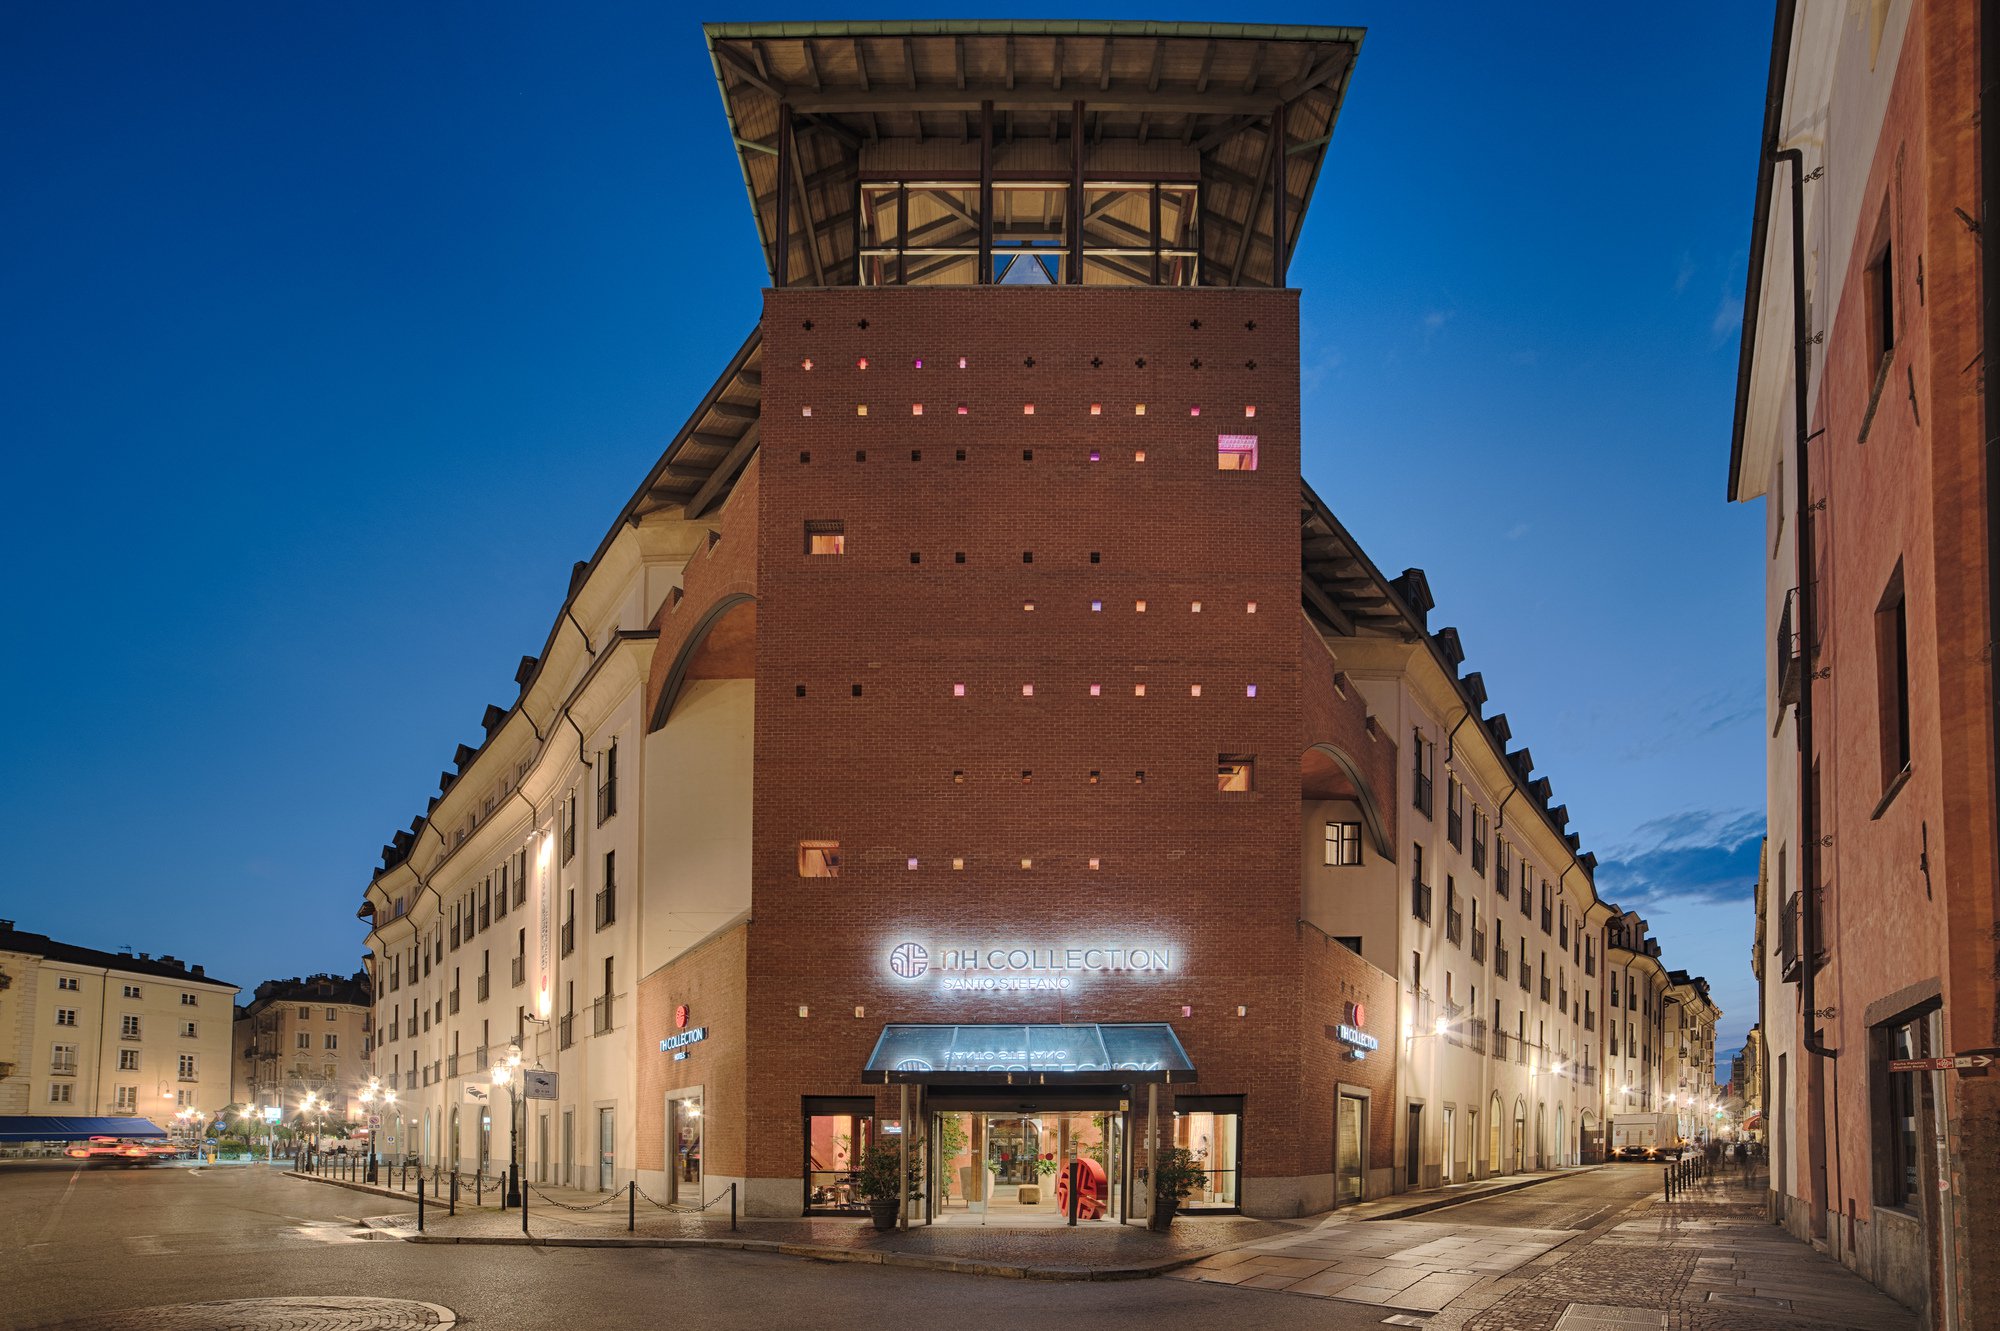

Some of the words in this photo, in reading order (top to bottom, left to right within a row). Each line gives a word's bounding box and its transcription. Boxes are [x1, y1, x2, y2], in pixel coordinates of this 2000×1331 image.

[987, 949, 1170, 971] COLLECTION
[943, 977, 996, 990] SANTO
[999, 977, 1071, 990] STEFANO
[667, 1028, 703, 1049] COLLECTION
[1349, 1029, 1378, 1050] COLLECTION
